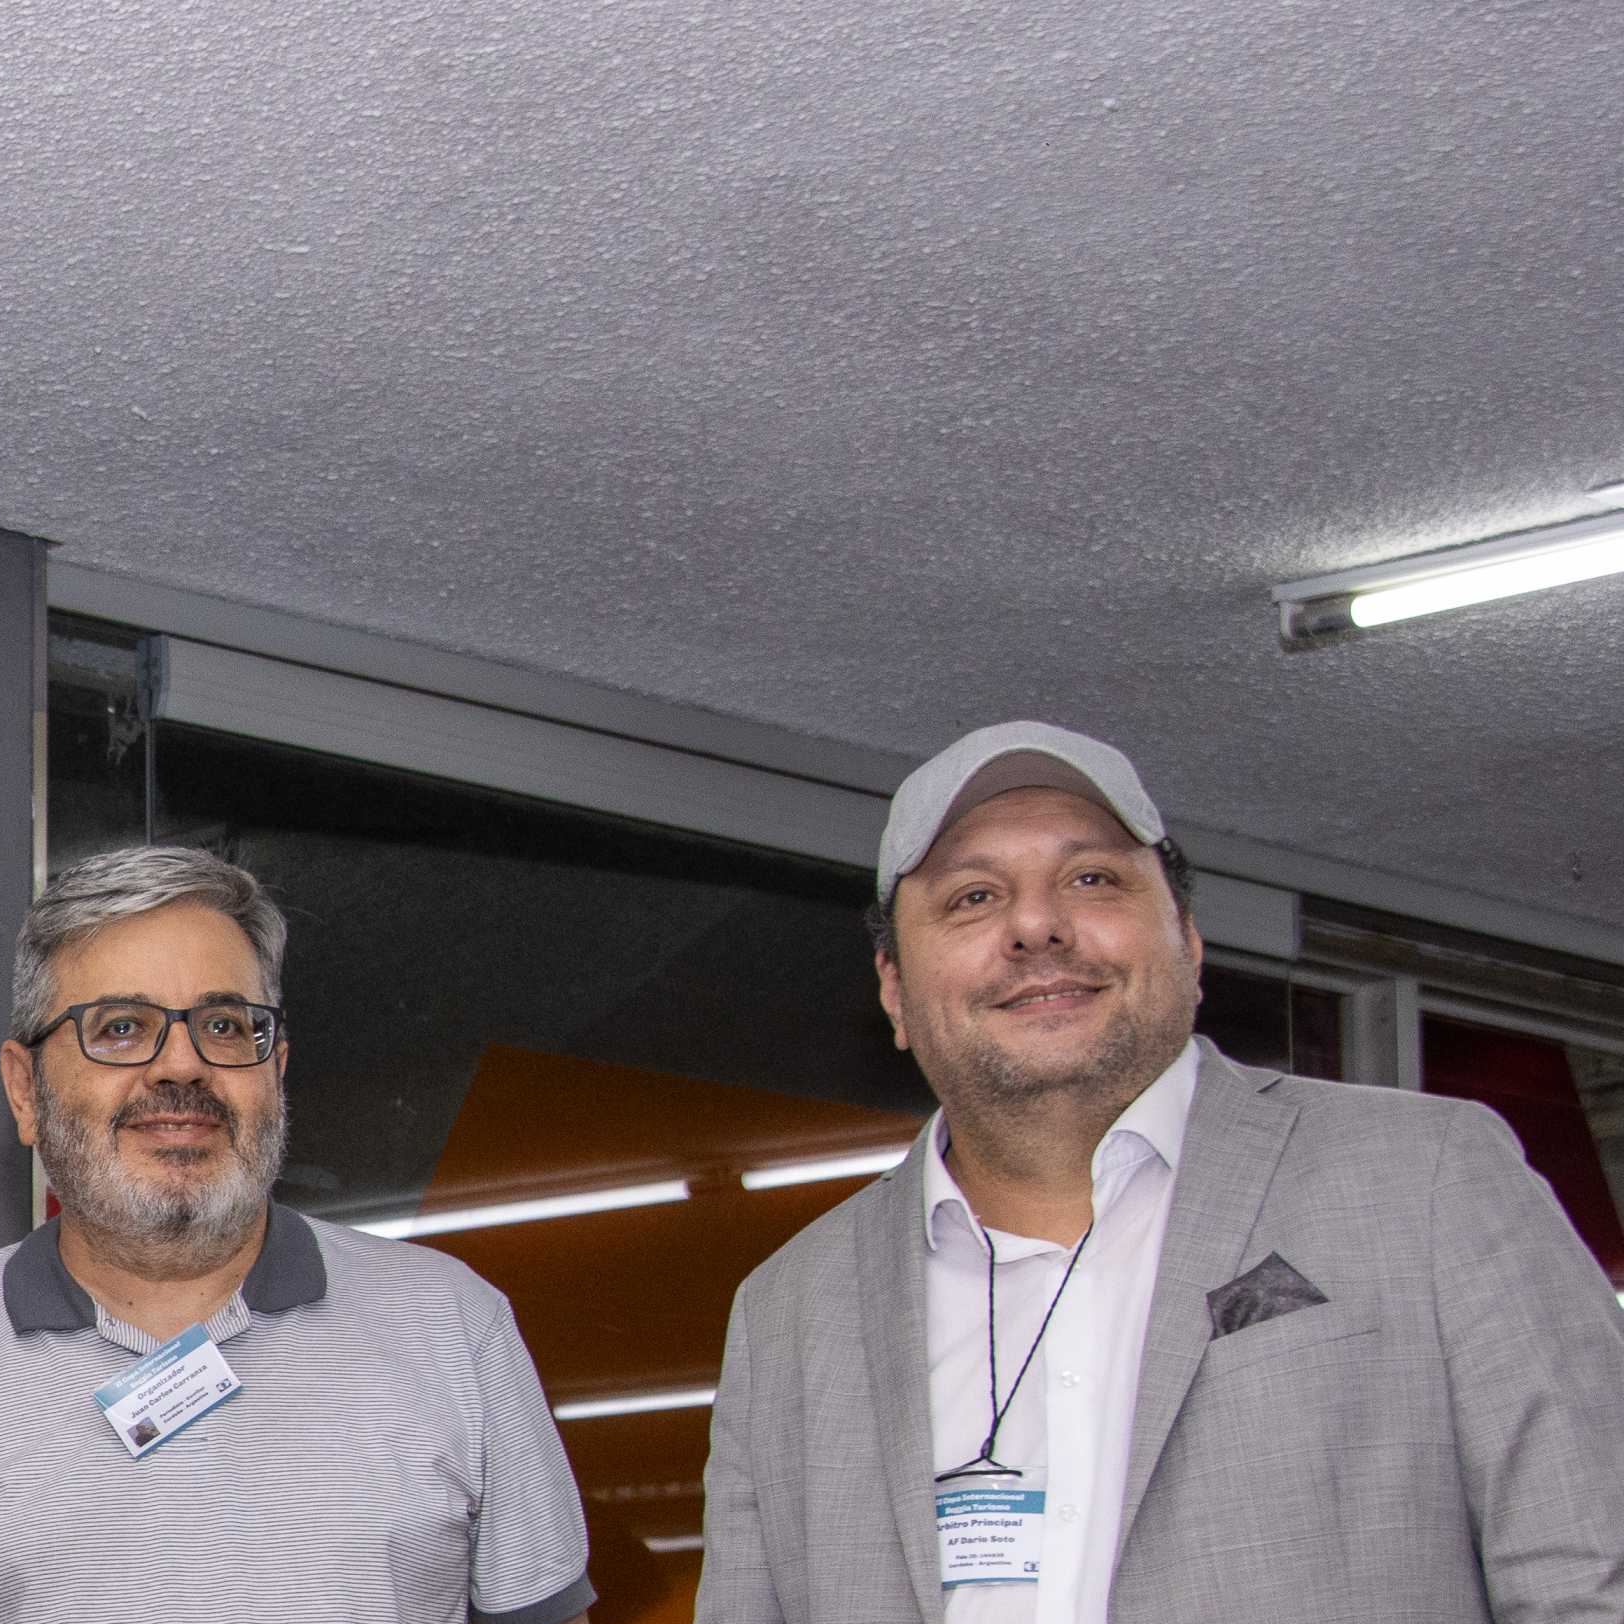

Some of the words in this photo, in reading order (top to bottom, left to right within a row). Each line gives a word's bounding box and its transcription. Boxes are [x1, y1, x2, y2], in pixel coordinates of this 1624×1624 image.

[137, 1365, 185, 1400] Organizador
[131, 1404, 149, 1418] Juan
[149, 1389, 173, 1406] Carlos
[971, 1519, 1023, 1528] Principal
